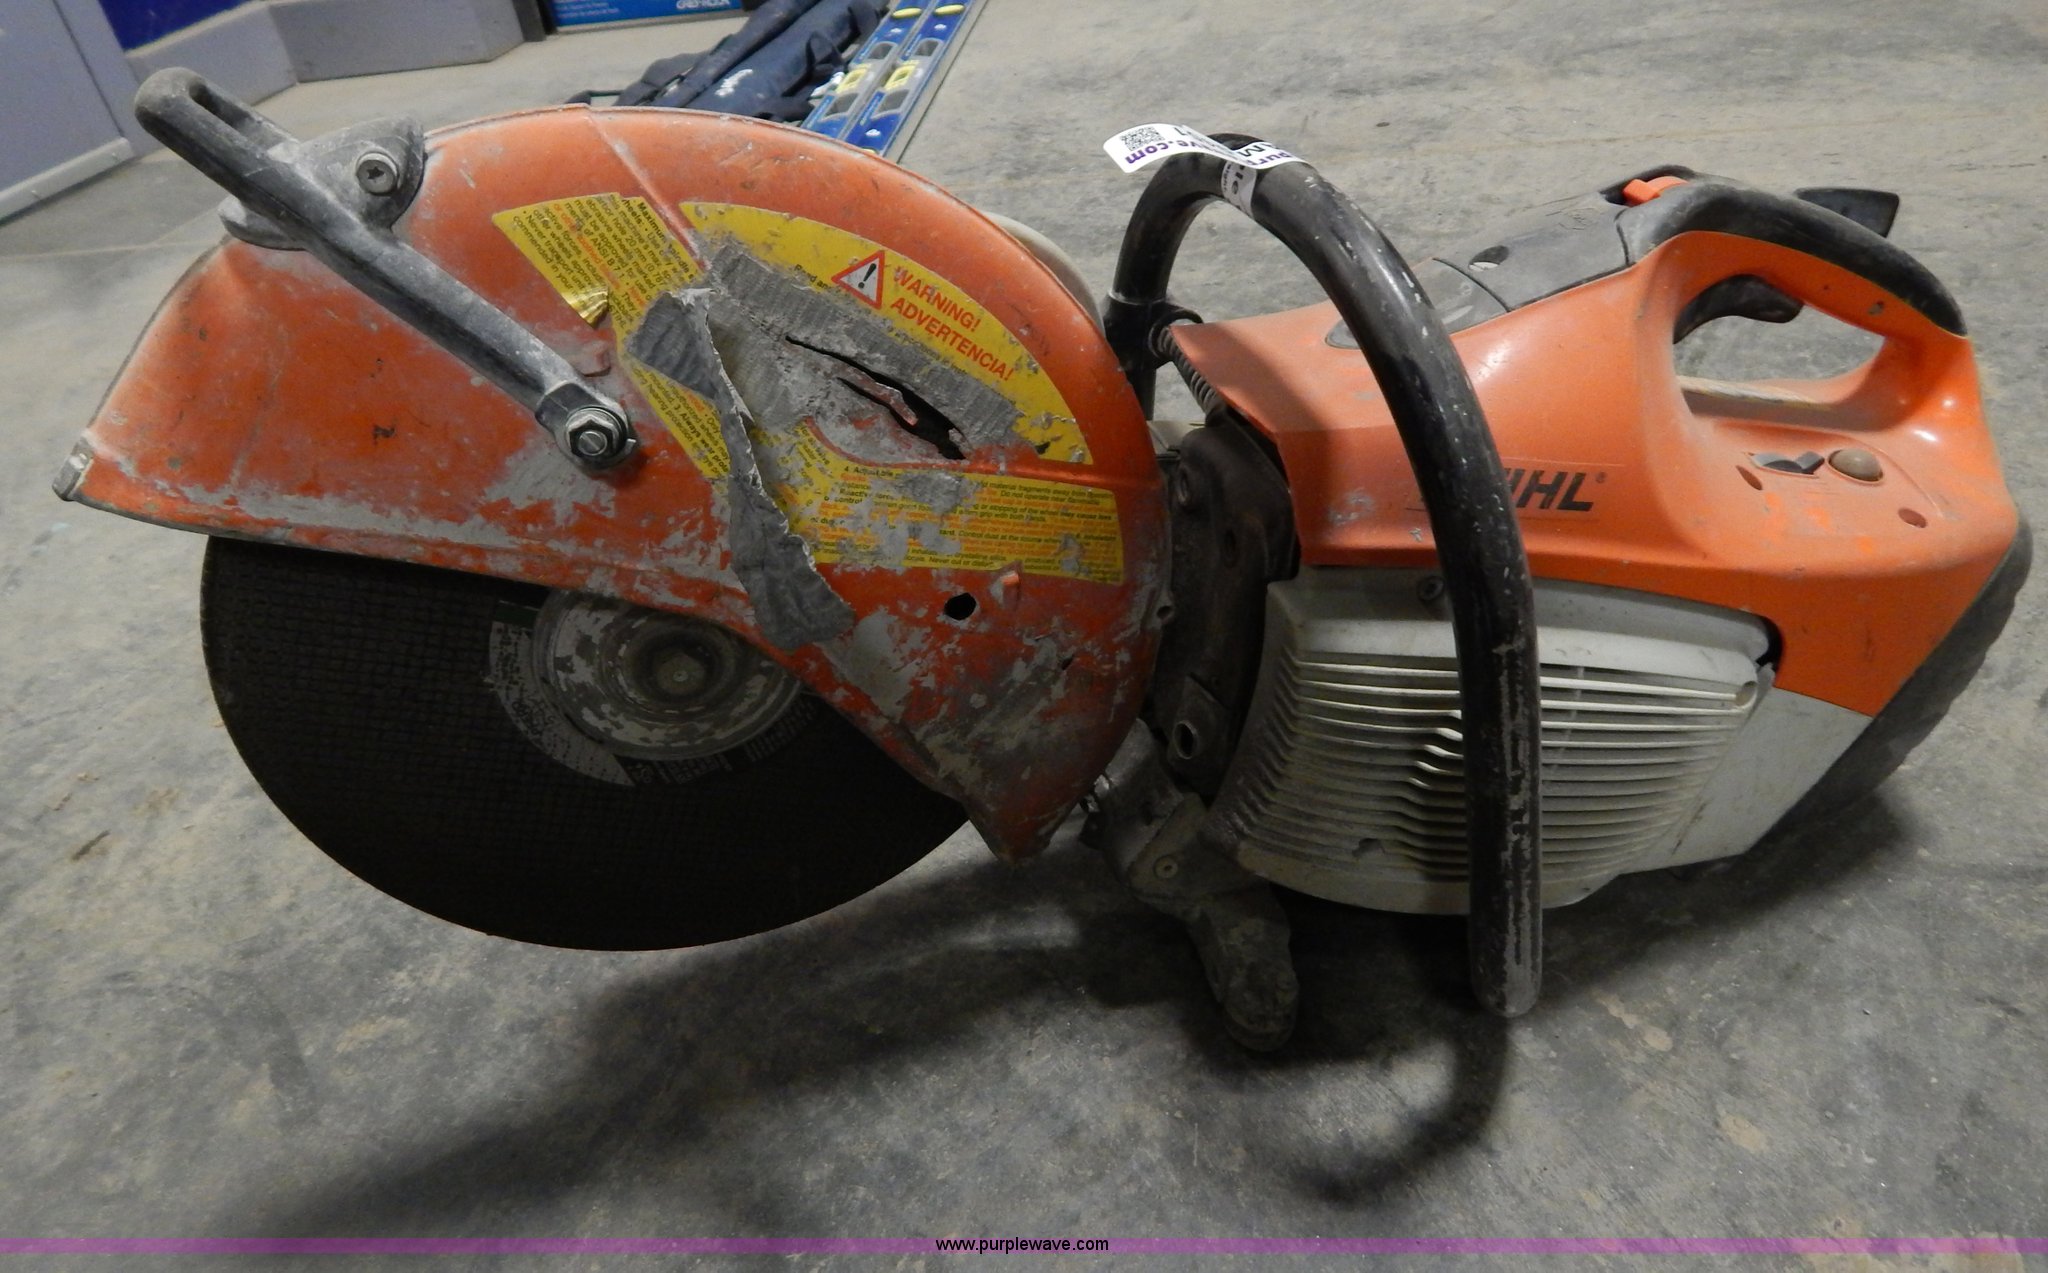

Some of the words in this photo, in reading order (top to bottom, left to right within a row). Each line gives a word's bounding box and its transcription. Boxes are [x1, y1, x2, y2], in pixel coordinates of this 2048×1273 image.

[893, 265, 981, 332] WARNING!
[890, 296, 1014, 381] ADVERTENCIA!
[1503, 467, 1595, 511] IHL
